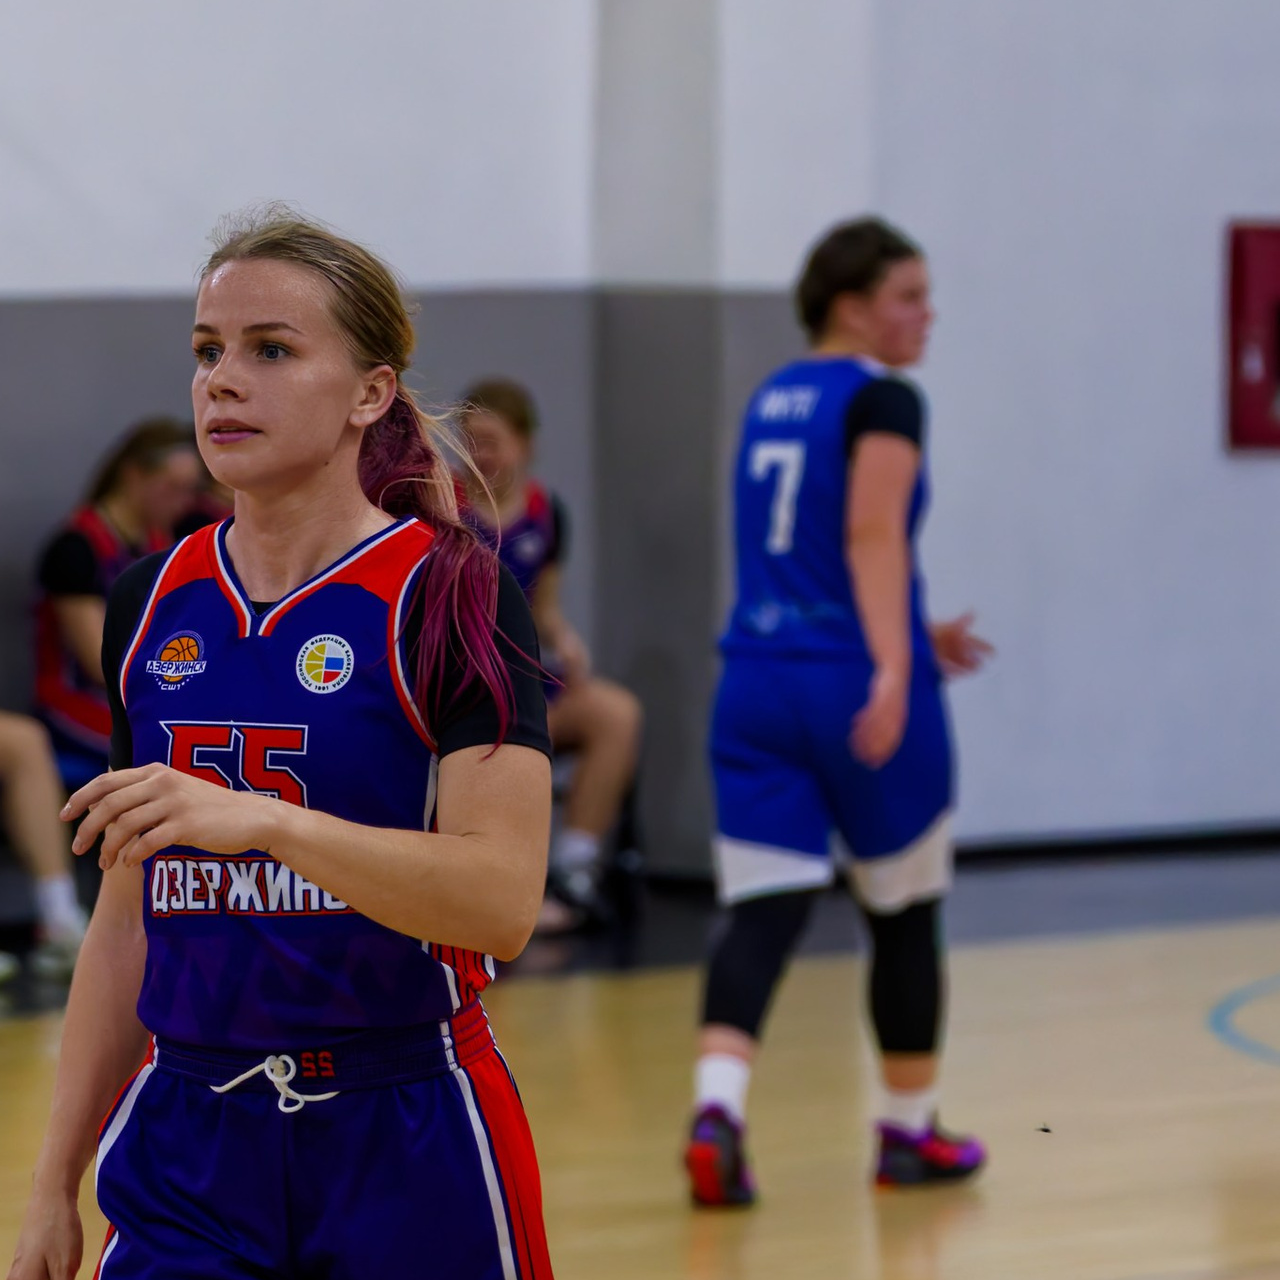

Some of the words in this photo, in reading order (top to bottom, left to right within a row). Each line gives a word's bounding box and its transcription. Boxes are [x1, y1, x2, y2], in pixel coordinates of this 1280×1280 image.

[749, 438, 807, 555] 7
[159, 720, 308, 810] 55
[152, 858, 352, 914] ДЗЕРЖИН
